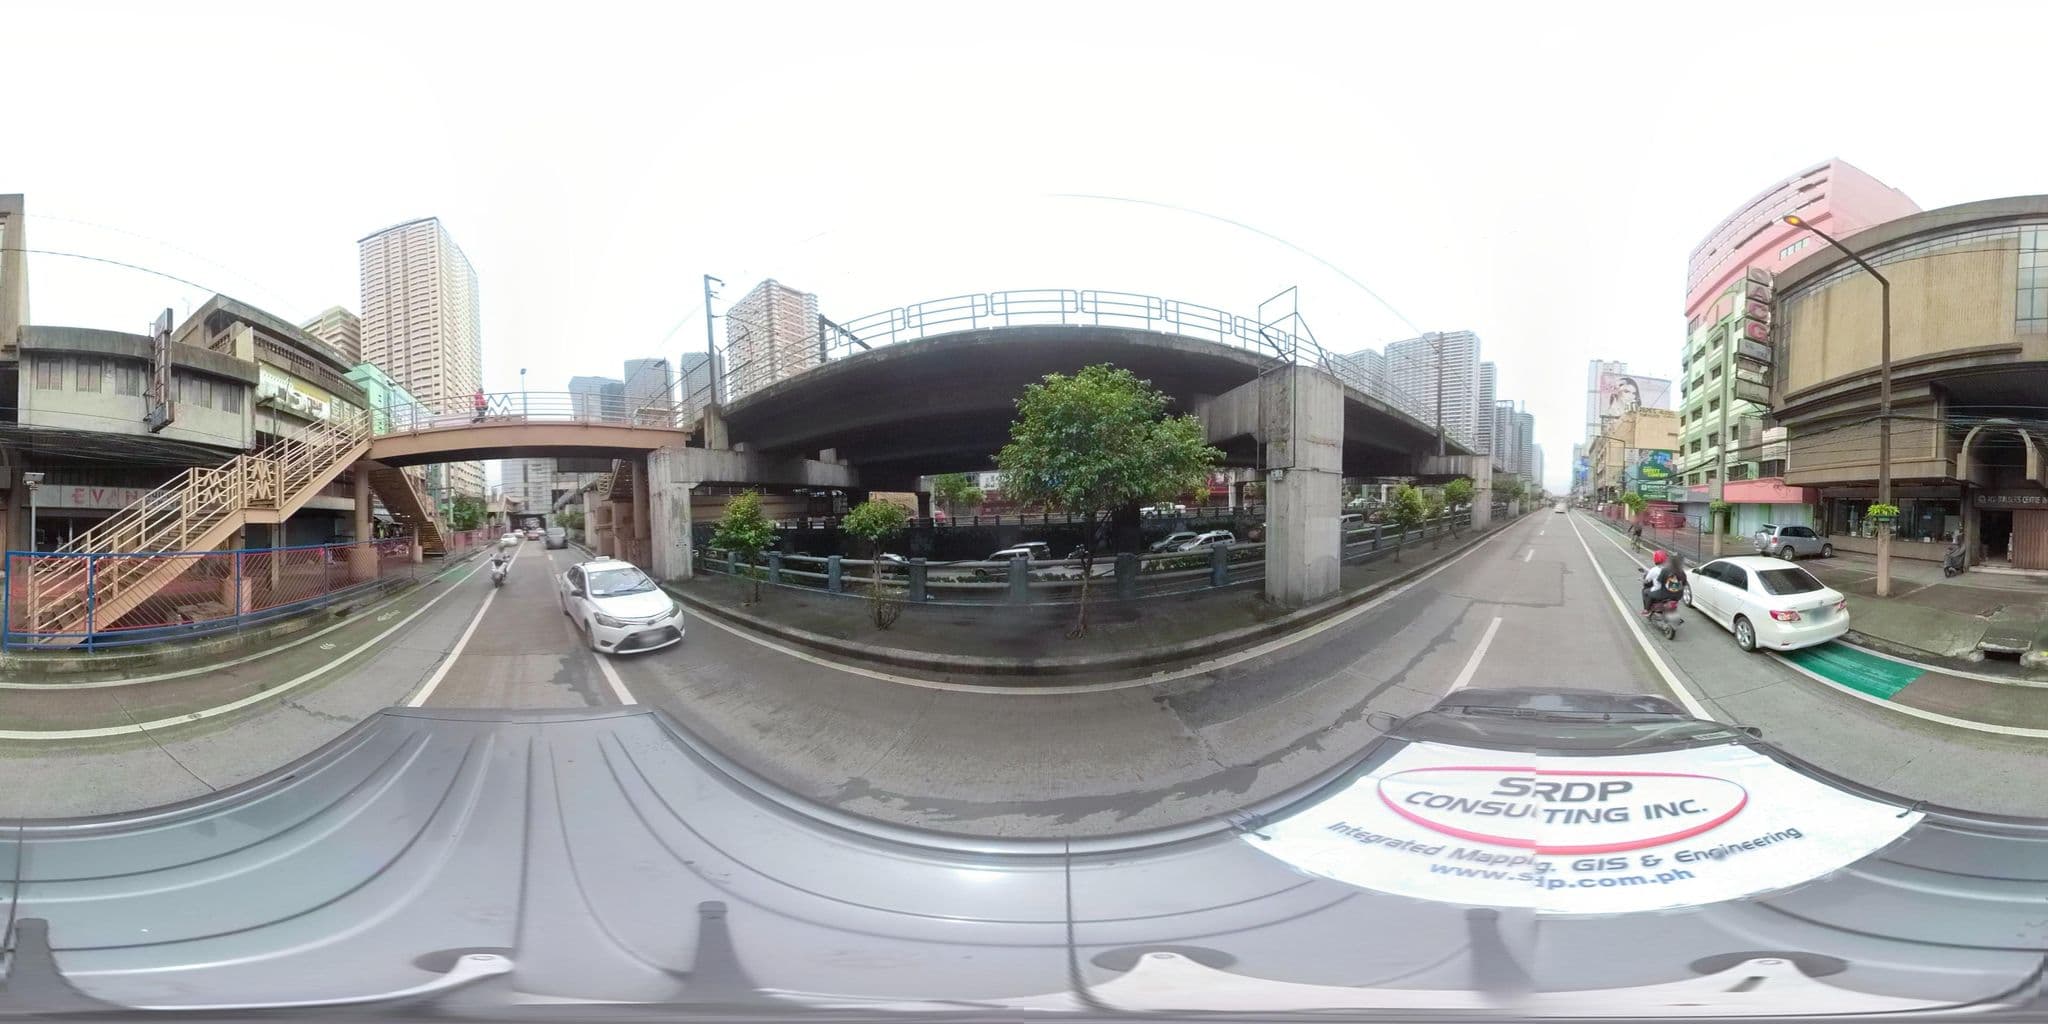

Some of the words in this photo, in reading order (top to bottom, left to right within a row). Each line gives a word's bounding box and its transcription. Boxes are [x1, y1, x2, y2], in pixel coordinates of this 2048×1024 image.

[1490, 776, 1633, 802] SRDP
[1644, 799, 1708, 820] INC.
[1327, 821, 1446, 855] Integrated
[1447, 848, 1556, 873] Mappig.
[1571, 856, 1629, 872] GIS
[1640, 854, 1663, 868] &
[1674, 827, 1804, 862] Engineering
